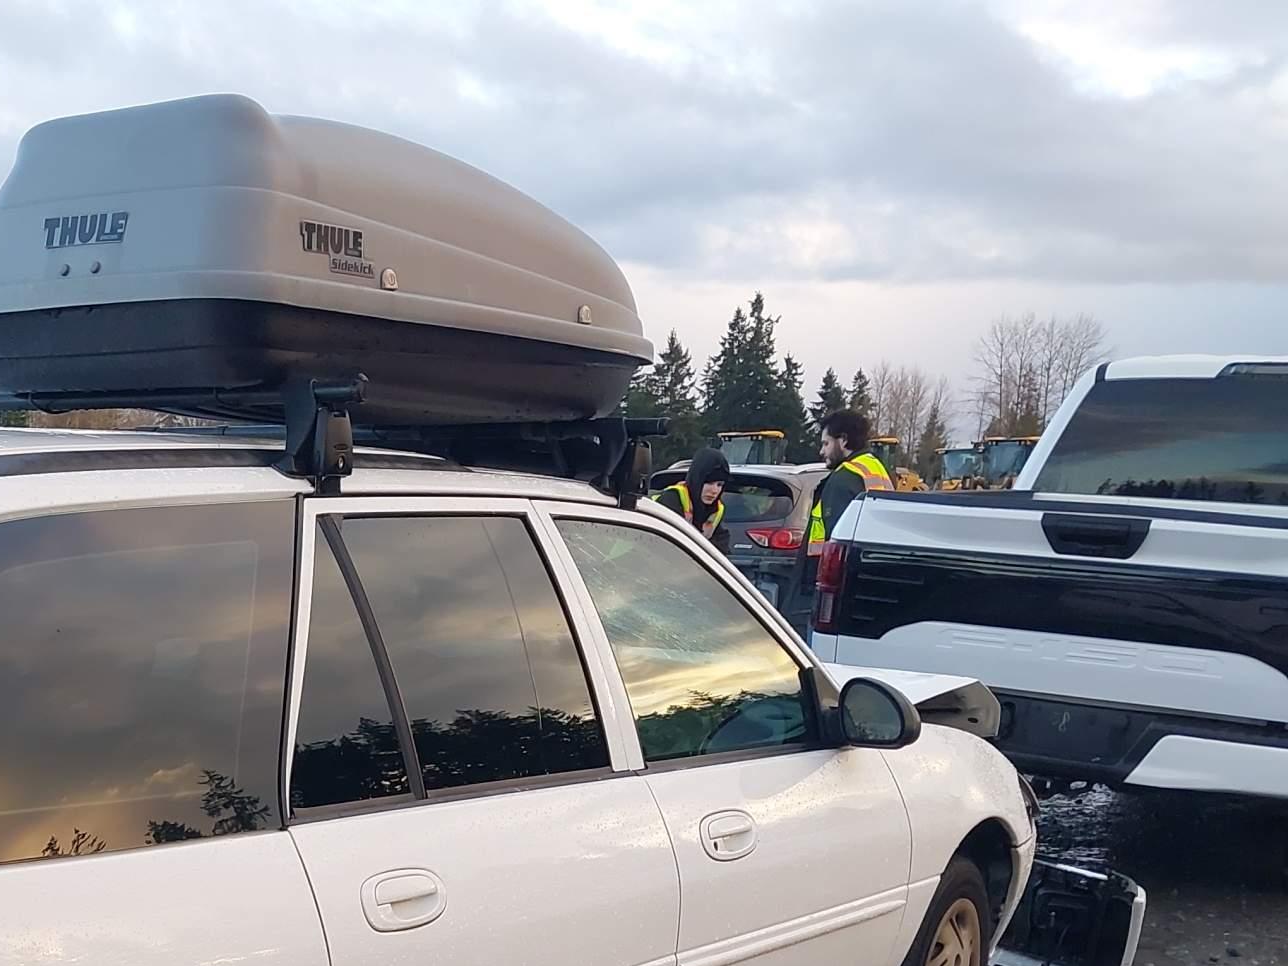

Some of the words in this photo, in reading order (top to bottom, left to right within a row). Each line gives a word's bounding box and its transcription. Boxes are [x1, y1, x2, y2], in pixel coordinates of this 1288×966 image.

[44, 211, 129, 249] THULE
[301, 220, 363, 259] THULE
[330, 258, 374, 276] Sidekick
